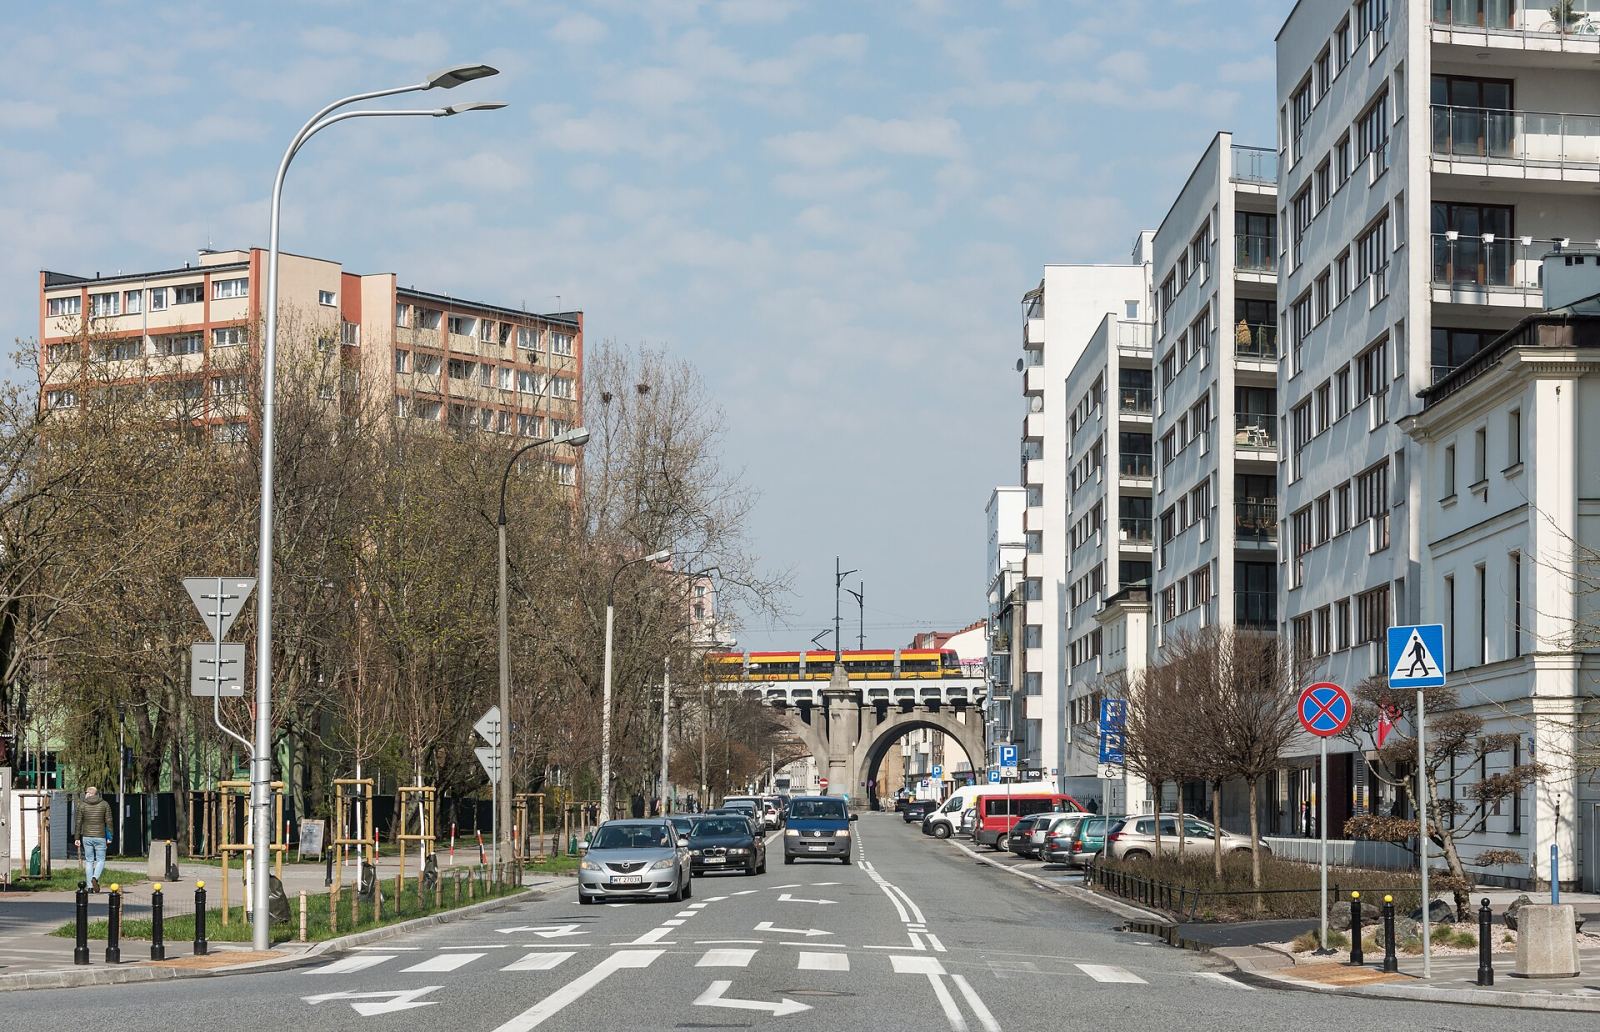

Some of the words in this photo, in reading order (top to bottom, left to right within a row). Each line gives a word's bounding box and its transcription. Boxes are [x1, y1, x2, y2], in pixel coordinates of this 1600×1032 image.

[1106, 702, 1121, 721] P
[1105, 733, 1120, 754] P
[1003, 747, 1013, 761] P
